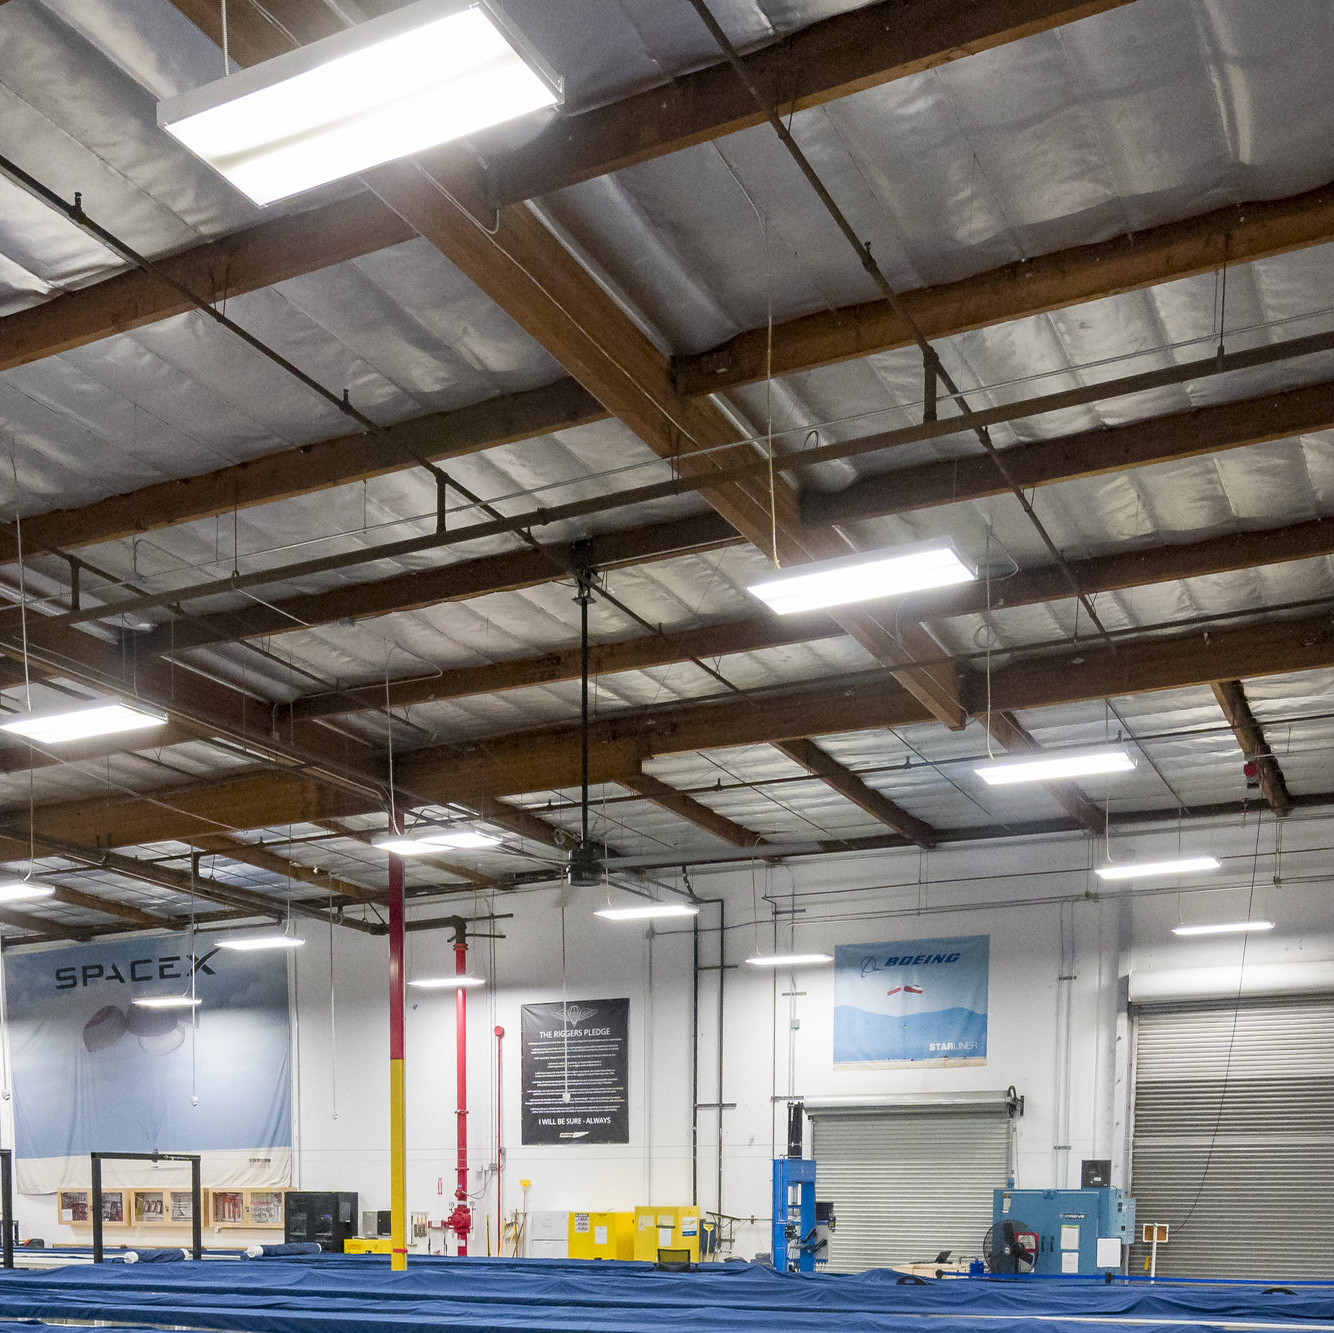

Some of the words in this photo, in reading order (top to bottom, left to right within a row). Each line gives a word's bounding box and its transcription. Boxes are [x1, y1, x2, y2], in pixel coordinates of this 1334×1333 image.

[884, 952, 961, 968] BOEING
[55, 947, 220, 990] SPACEX
[539, 1031, 553, 1039] THE
[554, 1029, 583, 1038] RIGGERS
[584, 1028, 611, 1036] PLEDGE
[929, 1041, 978, 1052] STARLINER
[542, 1118, 556, 1126] WILL
[557, 1118, 566, 1126] BE
[586, 1117, 611, 1125] ALWAYS
